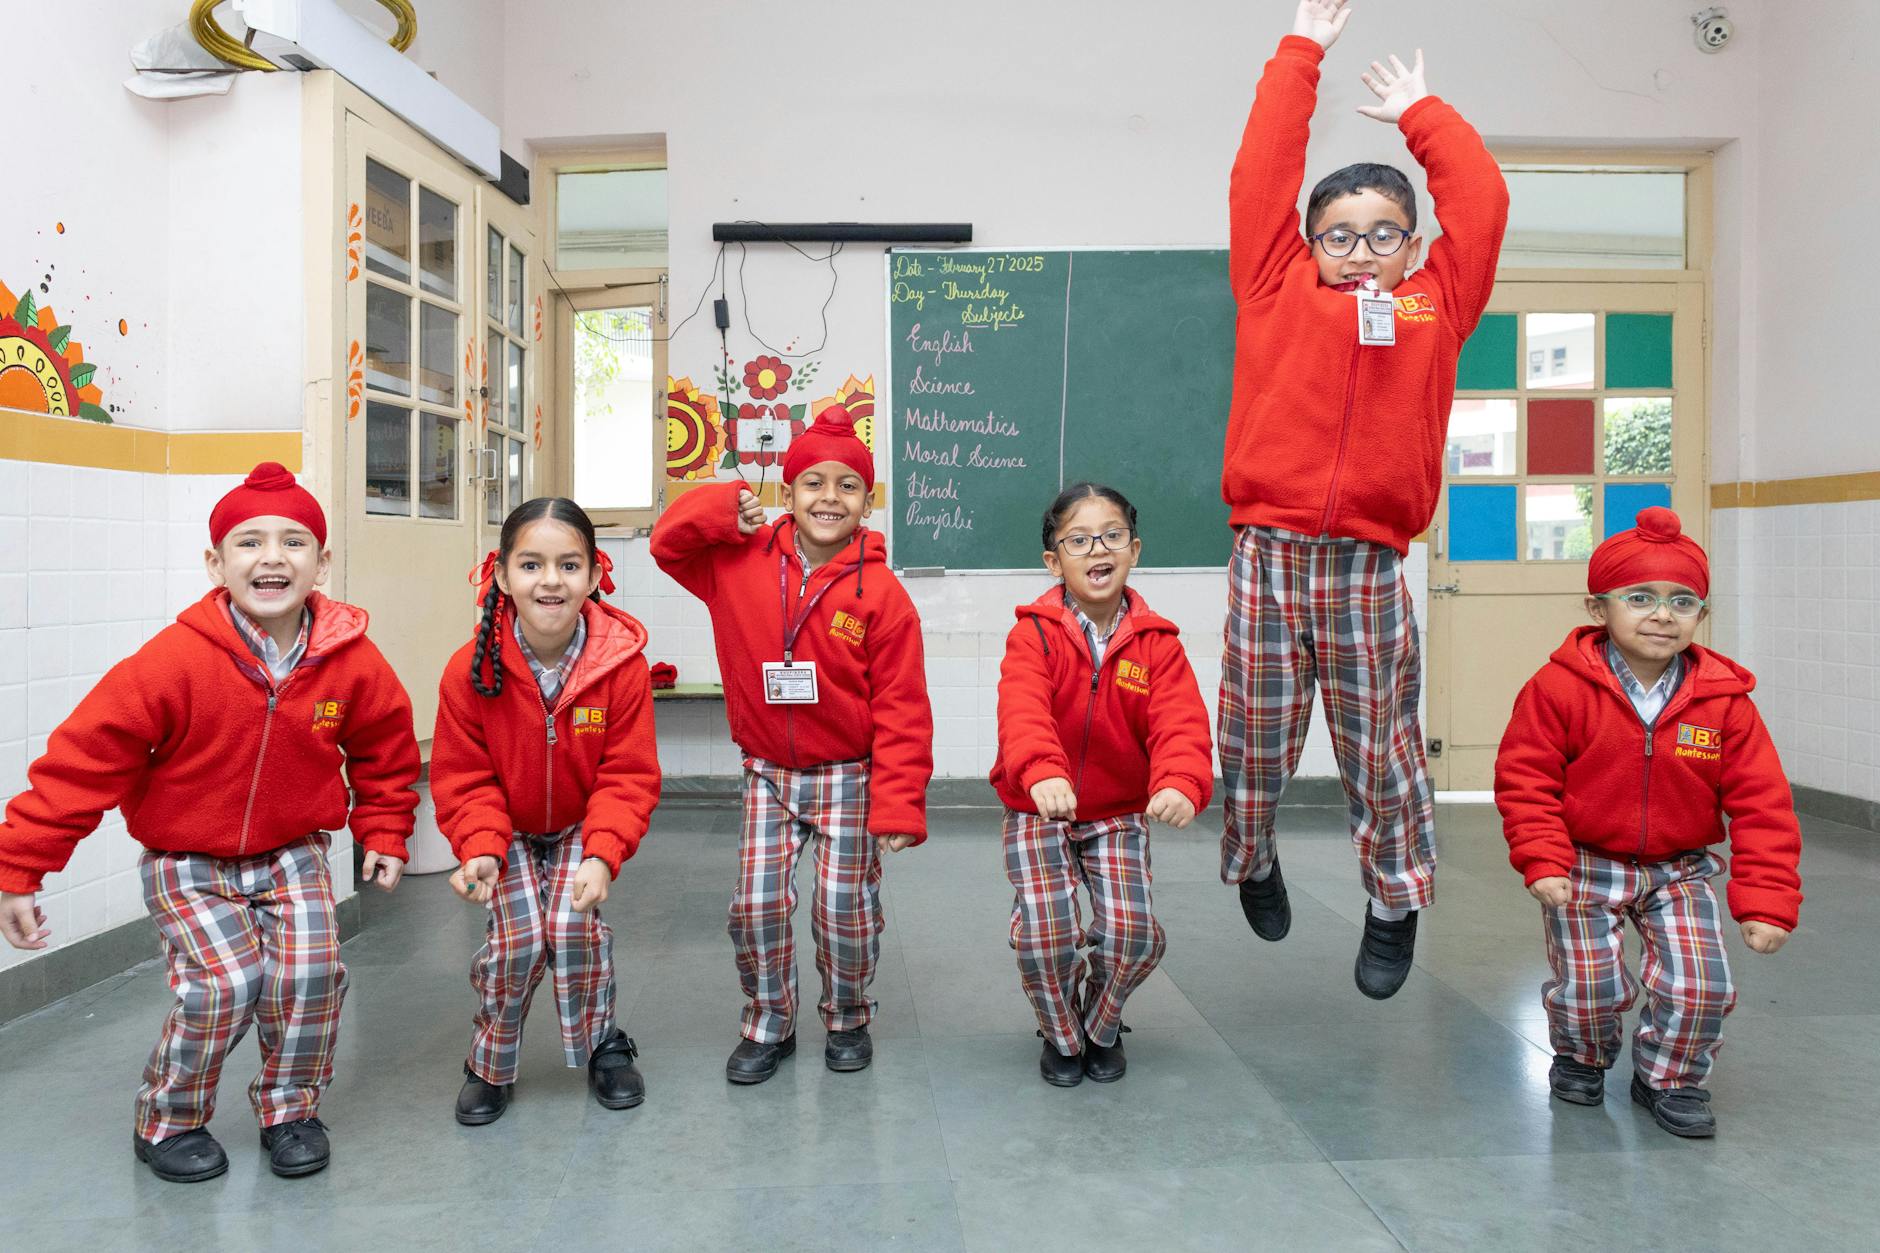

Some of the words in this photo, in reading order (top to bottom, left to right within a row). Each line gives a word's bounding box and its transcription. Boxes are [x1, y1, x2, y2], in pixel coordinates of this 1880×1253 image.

[893, 256, 925, 280] Date
[937, 256, 986, 284] February
[891, 281, 925, 311] Day
[942, 281, 1010, 305] Thursday
[961, 303, 1025, 331] Subjects
[906, 323, 974, 366] English
[909, 365, 975, 395] Science
[904, 407, 1020, 437] Mathematics
[902, 440, 962, 468] Moral
[966, 443, 1027, 468] Science
[906, 471, 961, 500] Hindi
[906, 500, 974, 540] Punjabi
